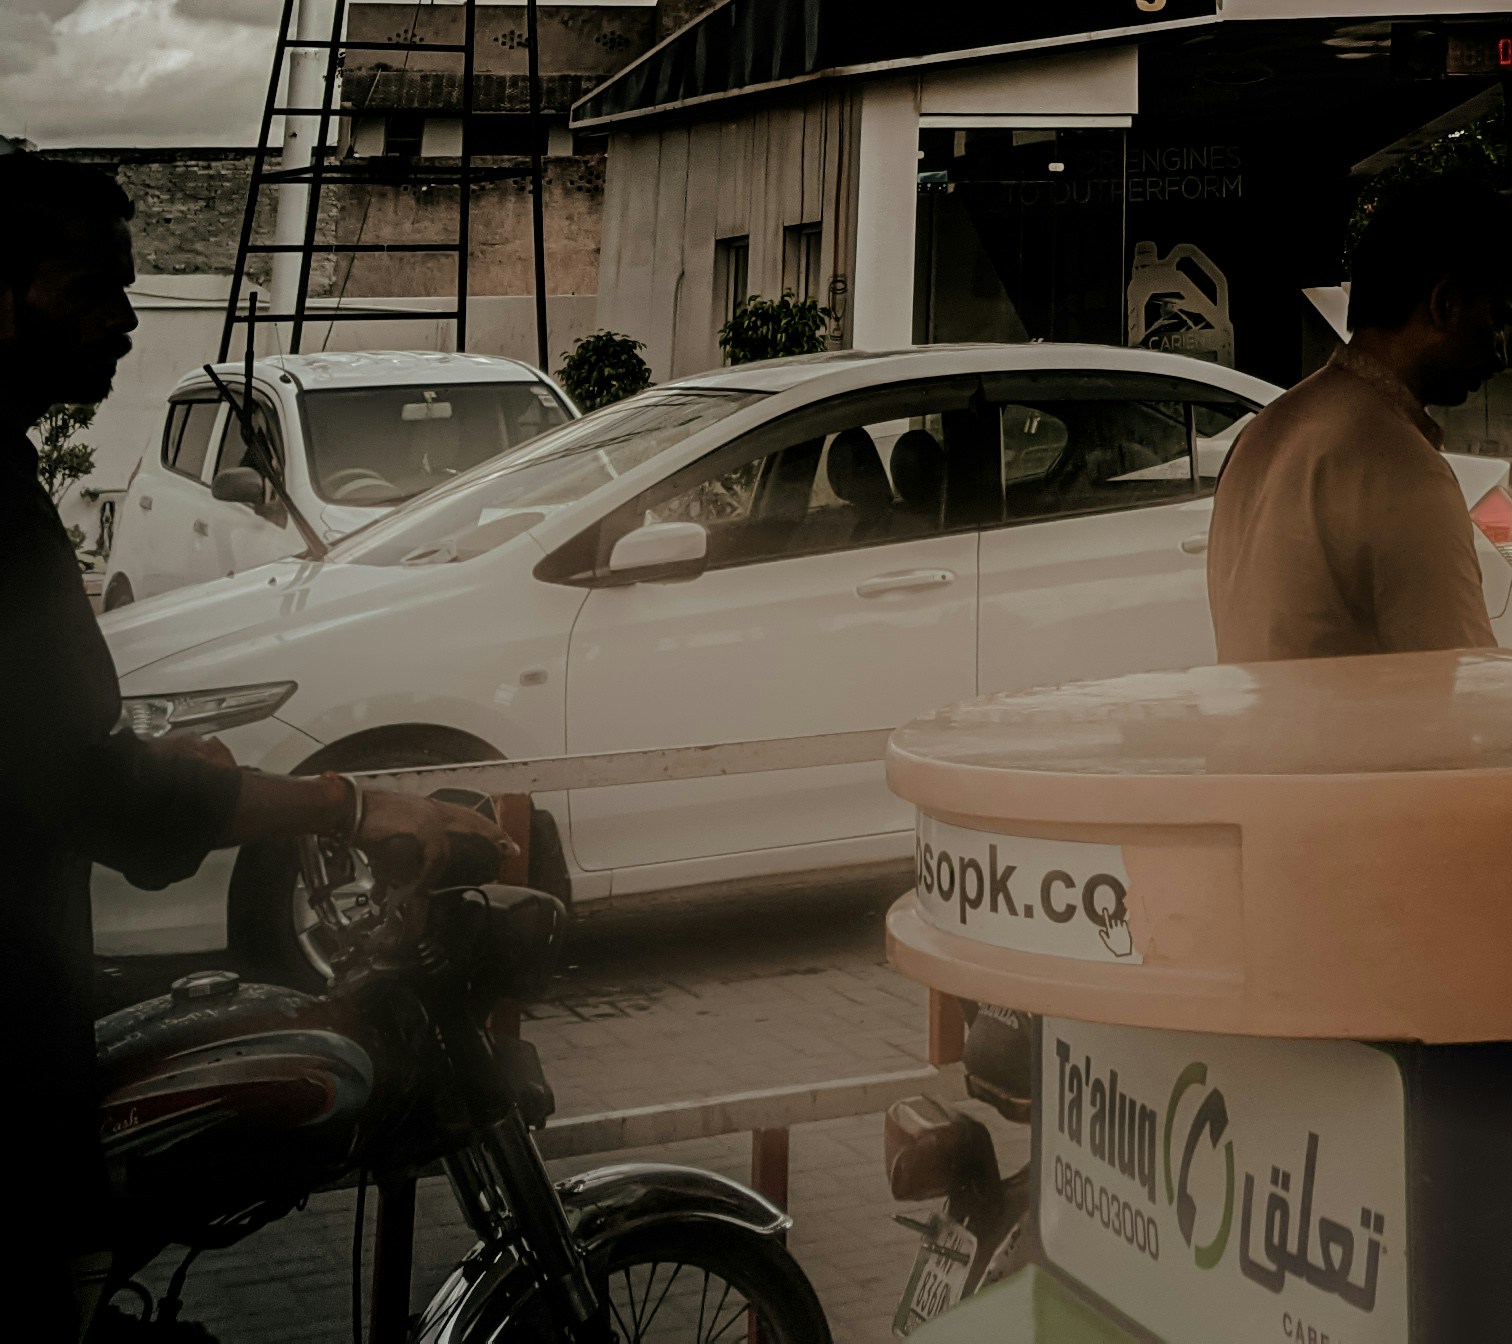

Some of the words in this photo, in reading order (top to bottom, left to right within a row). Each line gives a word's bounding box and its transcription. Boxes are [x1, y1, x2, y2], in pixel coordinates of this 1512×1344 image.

[1128, 144, 1242, 173] ENGINES
[1056, 1037, 1157, 1205] Ta'aluq
[1054, 1154, 1160, 1263] 0800-03000
[1239, 1130, 1385, 1313] تعلق
